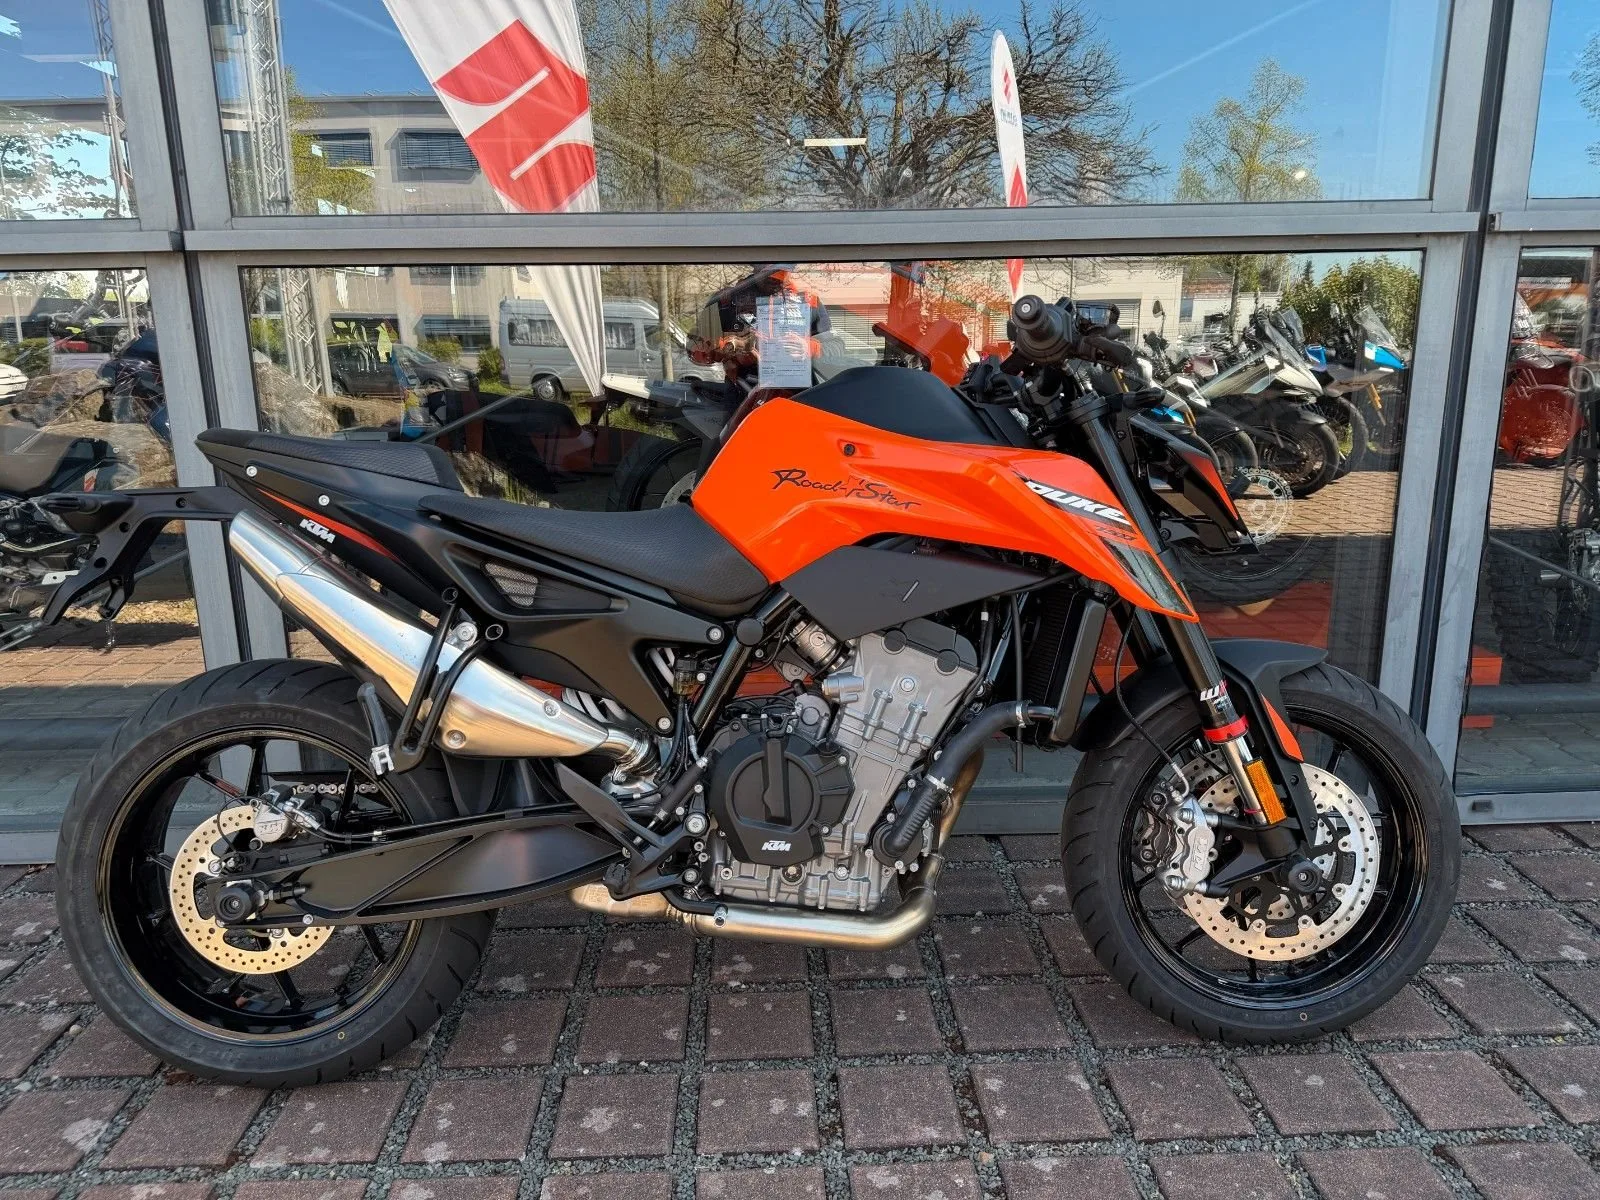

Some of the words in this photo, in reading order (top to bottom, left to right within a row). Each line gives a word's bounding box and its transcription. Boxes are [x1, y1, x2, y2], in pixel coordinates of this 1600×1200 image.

[1025, 481, 1131, 525] DUKE
[300, 519, 336, 543] KTM
[761, 840, 791, 851] KTM
